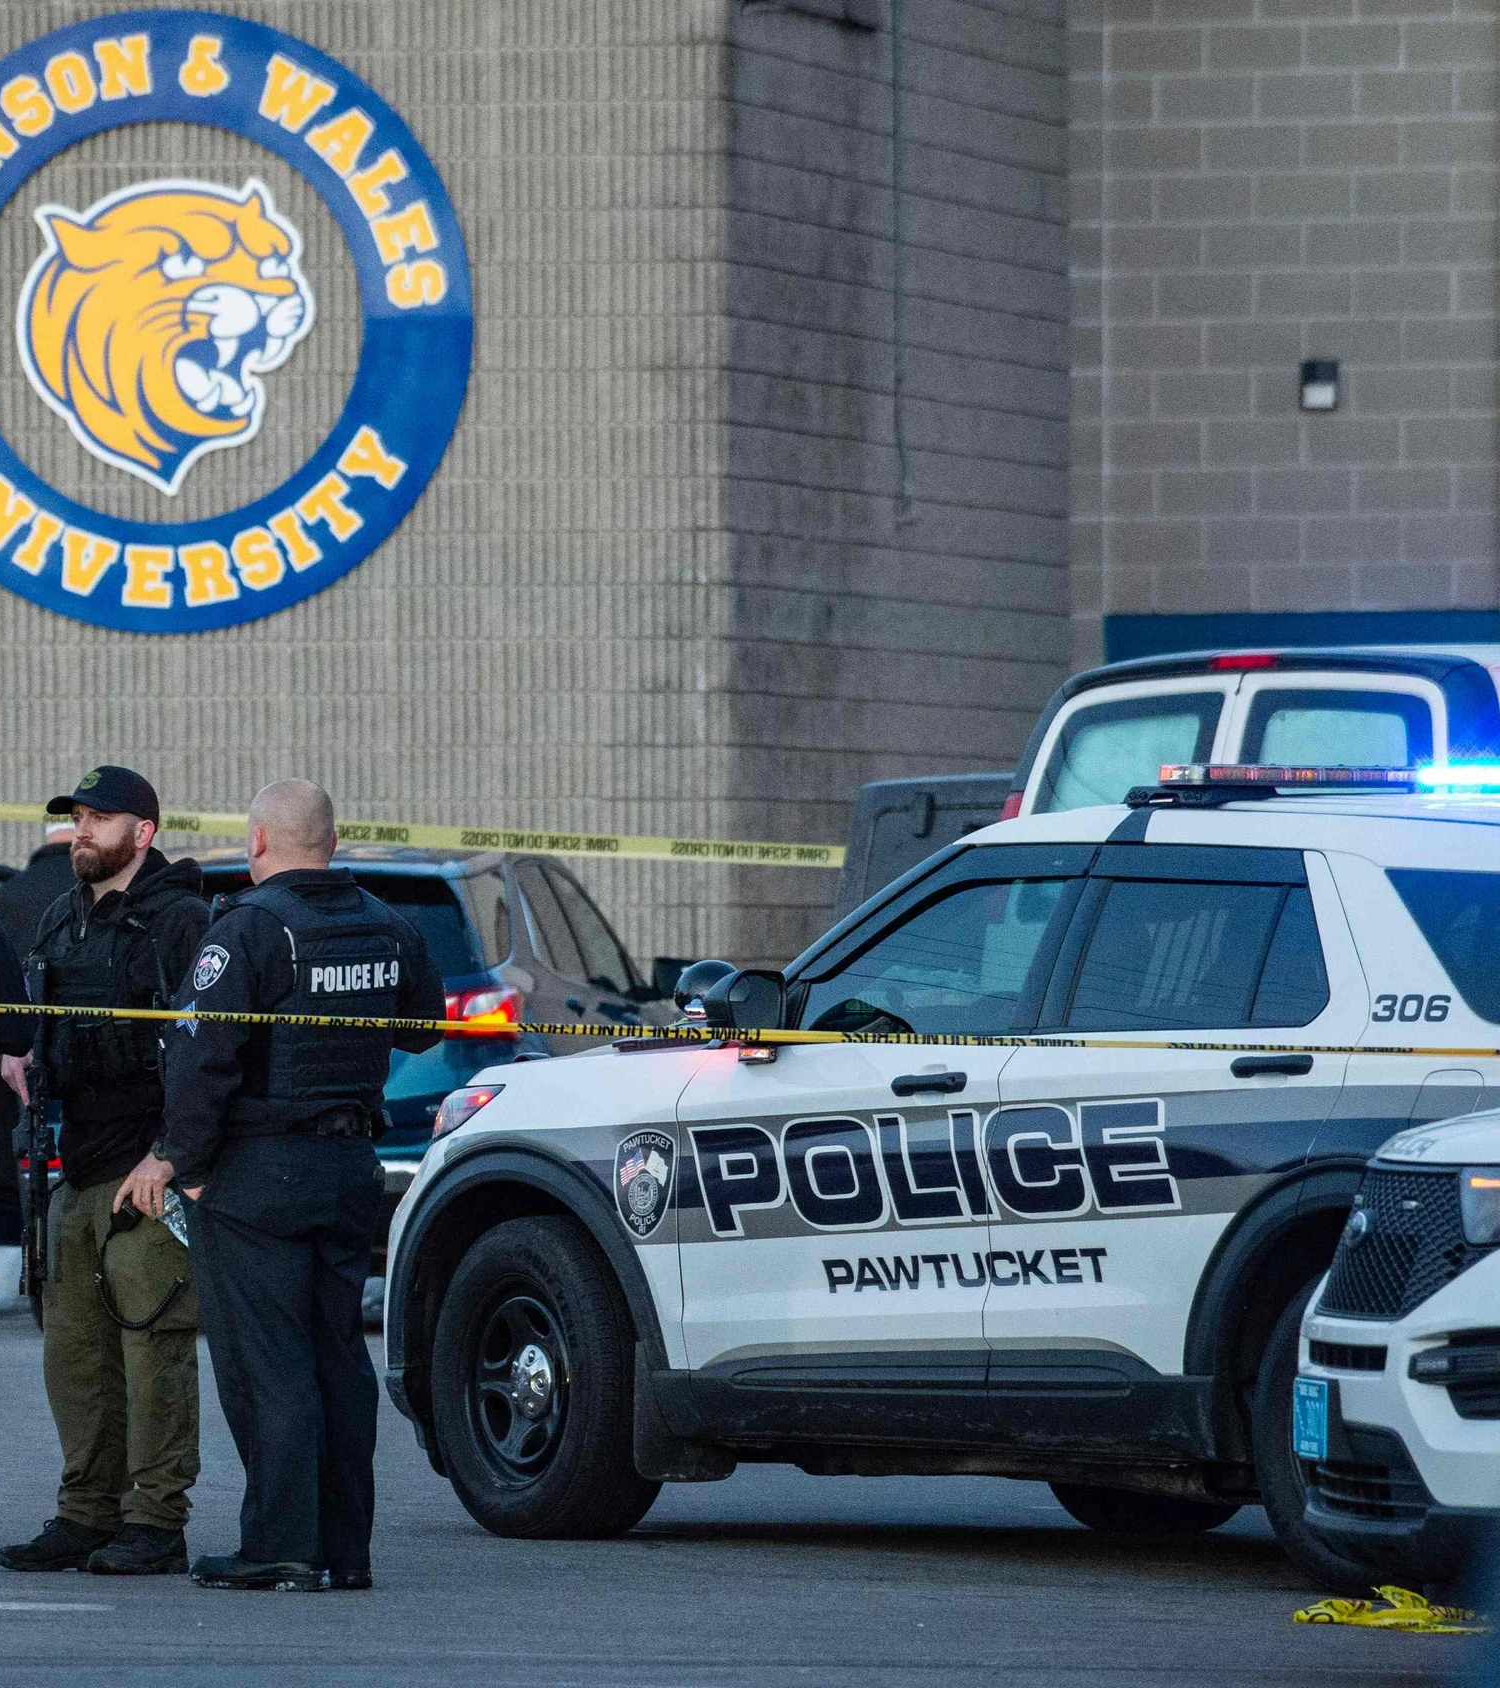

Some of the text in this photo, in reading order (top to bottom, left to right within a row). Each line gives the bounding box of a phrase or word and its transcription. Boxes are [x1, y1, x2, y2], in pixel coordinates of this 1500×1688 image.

[178, 36, 228, 97] &
[258, 53, 448, 310] WALES
[311, 961, 399, 993] POLICE K-9
[1371, 994, 1452, 1022] 306
[623, 1134, 671, 1153] PAWTUCKET
[688, 1098, 1183, 1238] POLICE
[629, 1212, 657, 1226] POLICE
[821, 1247, 1107, 1294] PAWTUCKET
